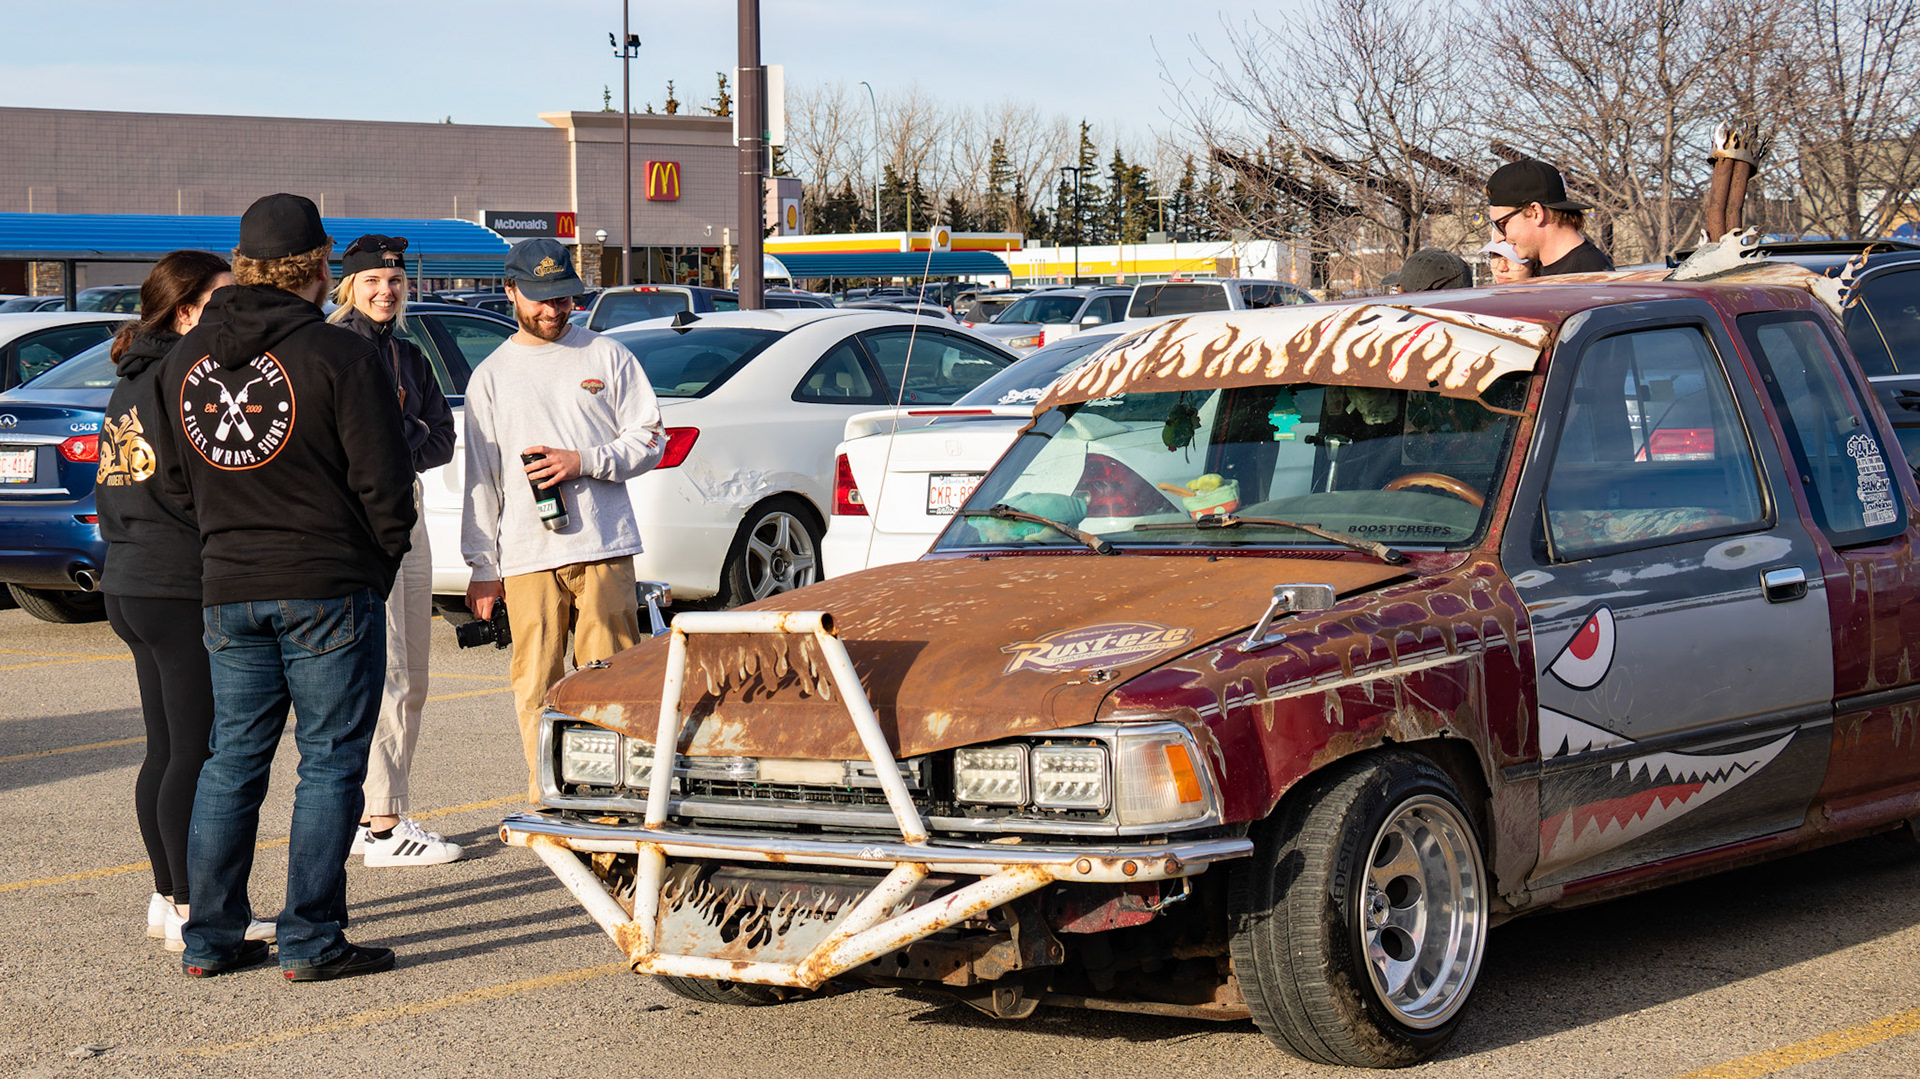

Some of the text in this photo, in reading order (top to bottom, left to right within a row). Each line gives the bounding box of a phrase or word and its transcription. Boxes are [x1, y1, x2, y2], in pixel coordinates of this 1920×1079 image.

[494, 218, 548, 230] McDonald's
[187, 358, 221, 387] DYNA
[203, 403, 263, 413] Est. 2009
[69, 422, 98, 432] Q50S
[184, 415, 289, 465] FLEET. WRAPS. SIGNS.
[1348, 524, 1452, 535] BOOSTCREEPS
